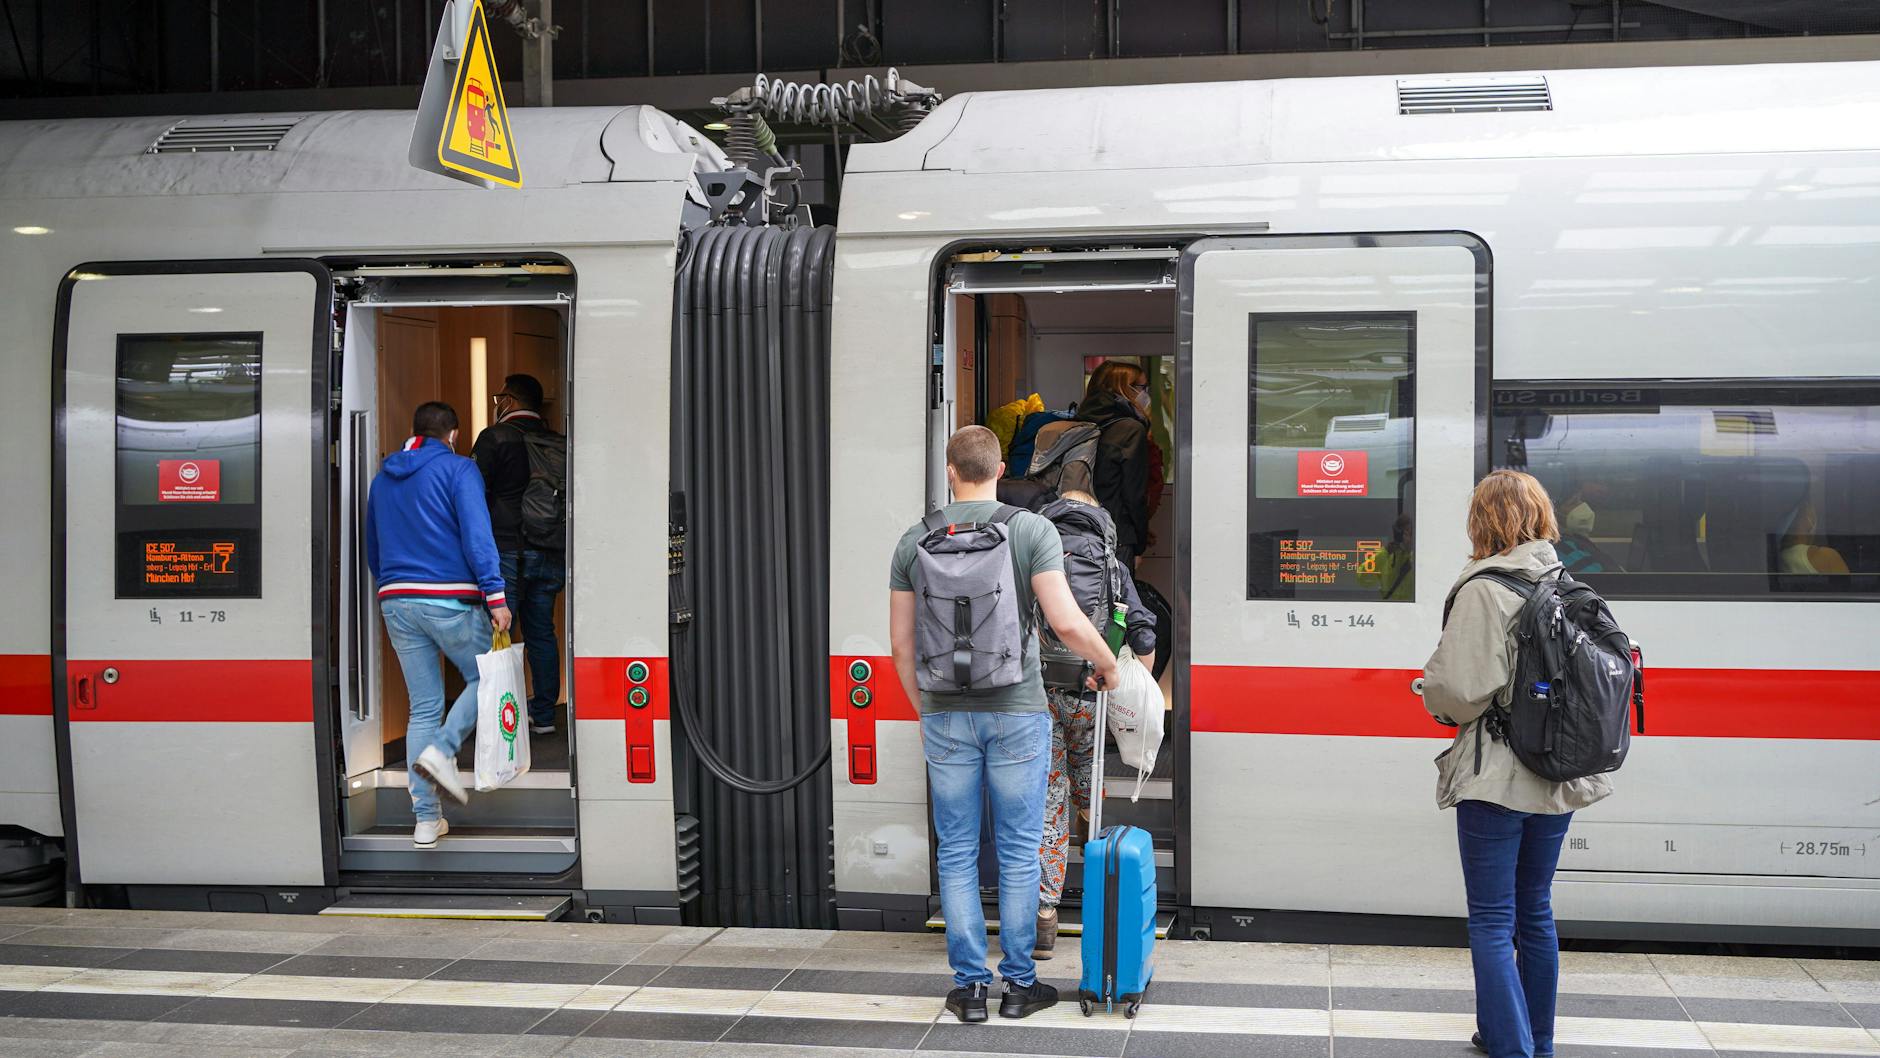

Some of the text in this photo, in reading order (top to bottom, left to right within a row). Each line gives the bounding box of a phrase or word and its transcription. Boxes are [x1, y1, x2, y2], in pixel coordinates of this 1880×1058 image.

[145, 543, 176, 553] ICE 507
[1280, 540, 1313, 551] ICE 507
[145, 553, 230, 573] Hamburg-Altona 7
[1280, 551, 1376, 572] Hamburg-Altona 8
[146, 572, 195, 583] München Hbf
[1280, 572, 1336, 584] München Hbf
[179, 611, 193, 623] 11
[210, 610, 226, 623] 78
[1311, 614, 1328, 627] 81
[1348, 614, 1375, 628] 144
[1569, 838, 1590, 850] HBL
[1664, 840, 1677, 852] 1L
[1796, 841, 1850, 856] 28.75m
